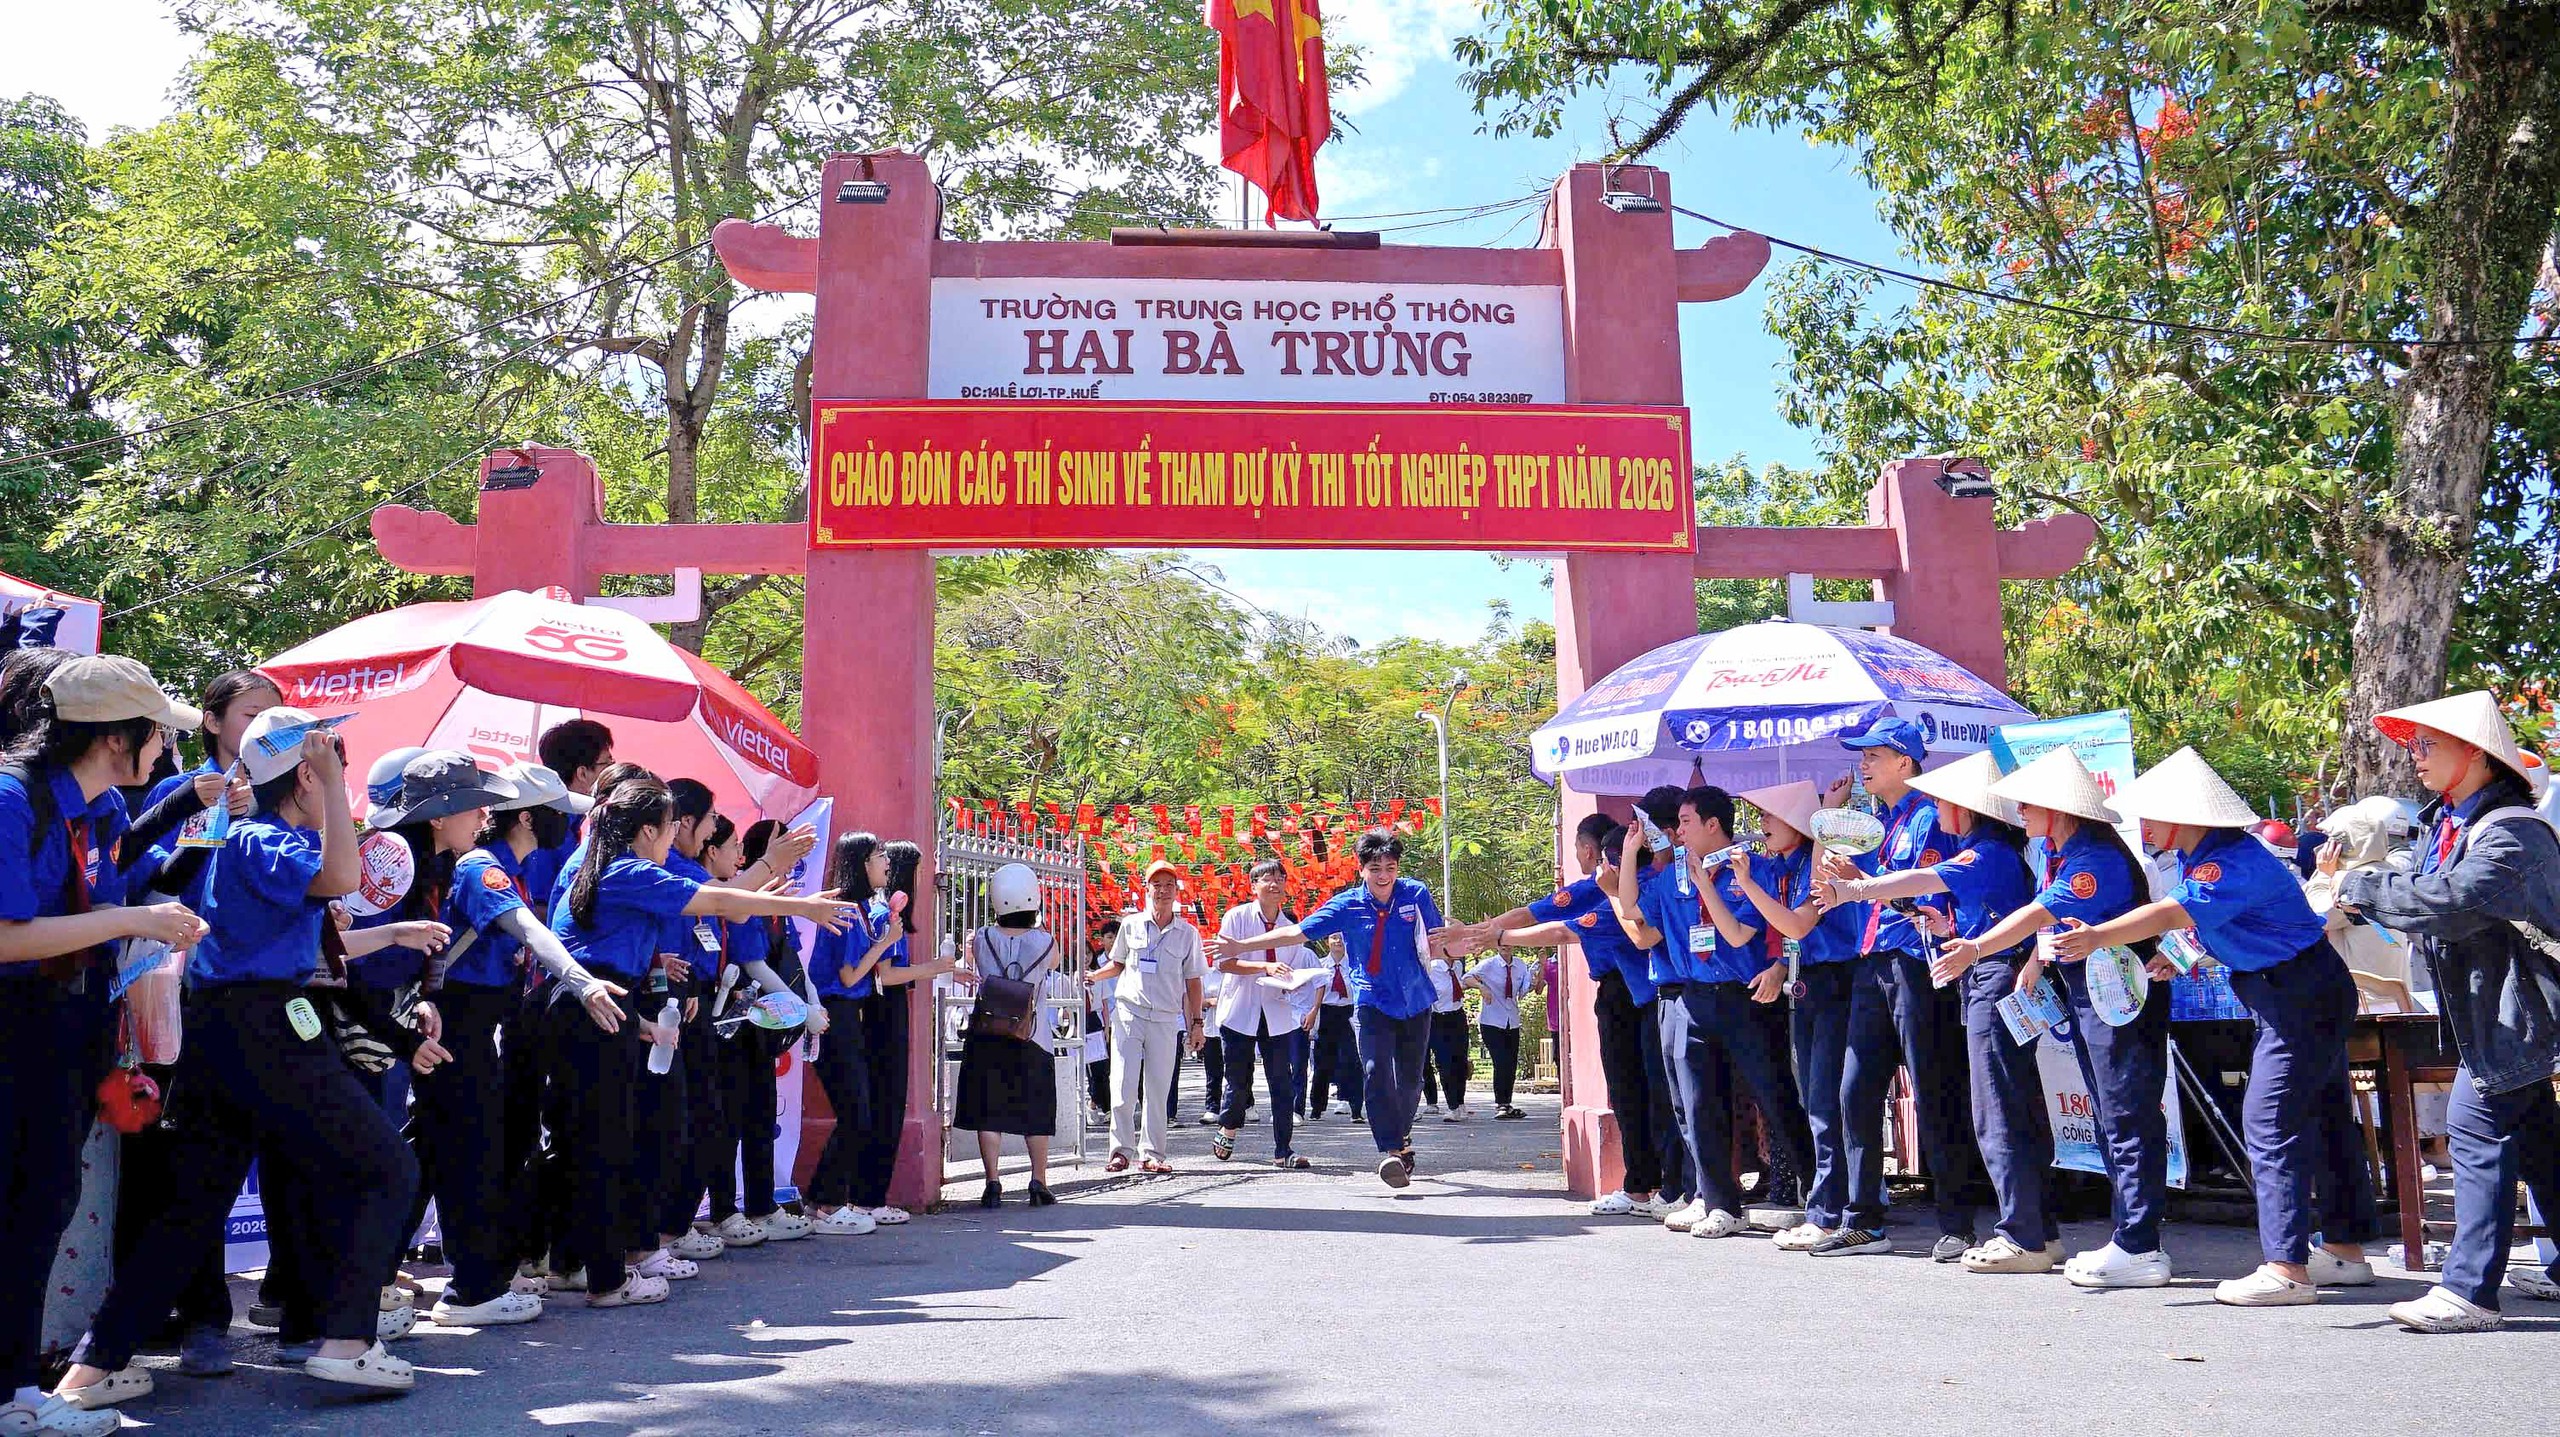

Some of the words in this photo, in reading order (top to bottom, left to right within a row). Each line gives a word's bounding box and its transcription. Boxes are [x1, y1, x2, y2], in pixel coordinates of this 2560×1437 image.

[980, 293, 1116, 319] TRƯỜNG
[1135, 300, 1242, 320] TRUNG
[1254, 301, 1320, 325] HỌC
[1332, 293, 1396, 321] PHỔ
[1406, 299, 1515, 324] THÔNG
[1023, 330, 1134, 375] HAI
[1163, 321, 1244, 375] BÀ
[1271, 323, 1472, 376] TRƯNG
[830, 440, 894, 506] CHÀO
[901, 440, 951, 506] ĐÓN
[959, 440, 1006, 505] CÁC
[1014, 440, 1051, 505] THÍ
[1058, 451, 1116, 505] SINH
[1123, 434, 1151, 505] VỀ
[1158, 452, 1225, 505] THAM
[1233, 447, 1267, 518] DỰ
[1273, 441, 1302, 507] KỲ
[1308, 454, 1345, 507] THI
[1352, 433, 1394, 507] TỐT
[1400, 442, 1487, 520] NGHIỆP
[1493, 455, 1550, 508] THPT
[1557, 444, 1612, 509] NĂM
[1619, 457, 1674, 511] 2026
[524, 625, 628, 661] 5G
[297, 662, 405, 698] viettel
[725, 715, 791, 774] viettel
[1575, 728, 1638, 757] HueWACO
[1941, 720, 1988, 744] HueWA
[2062, 1123, 2092, 1143] CÔNG
